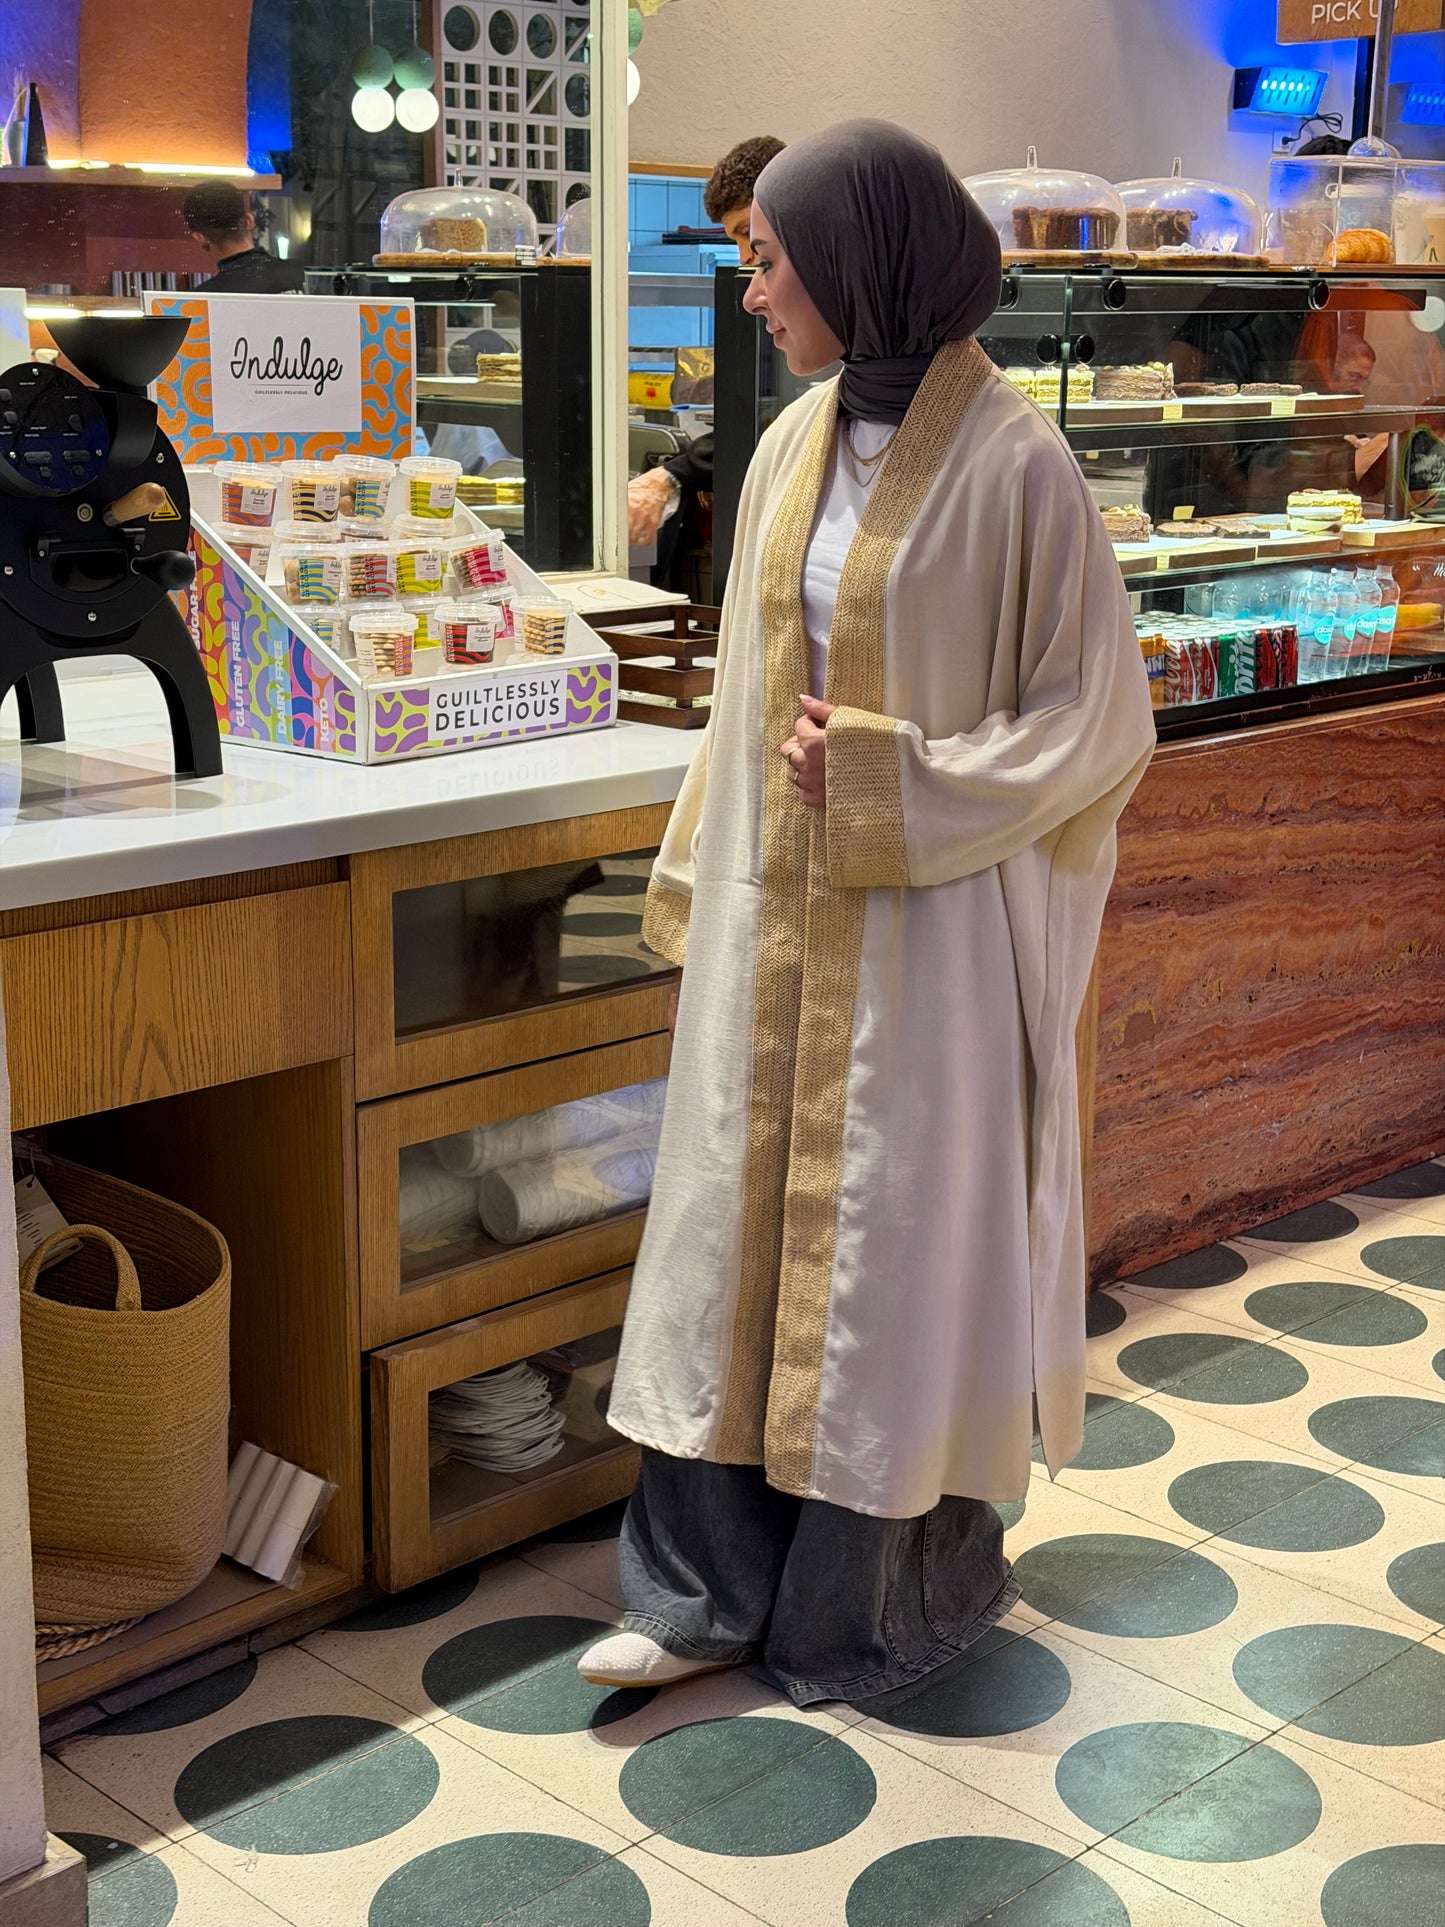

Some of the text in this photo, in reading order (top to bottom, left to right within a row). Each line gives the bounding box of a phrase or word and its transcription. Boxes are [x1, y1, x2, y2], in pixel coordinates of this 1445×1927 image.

[1311, 0, 1361, 25] PICK
[230, 336, 343, 396] Indulge
[188, 550, 198, 591] FE
[231, 620, 245, 728] GLUTEN FREE
[1229, 631, 1256, 695] prite
[273, 640, 286, 735] DAIRY FREE
[436, 679, 560, 709] GUILTLESSLY
[319, 697, 330, 743] KETO
[435, 698, 560, 731] DELICIOUS
